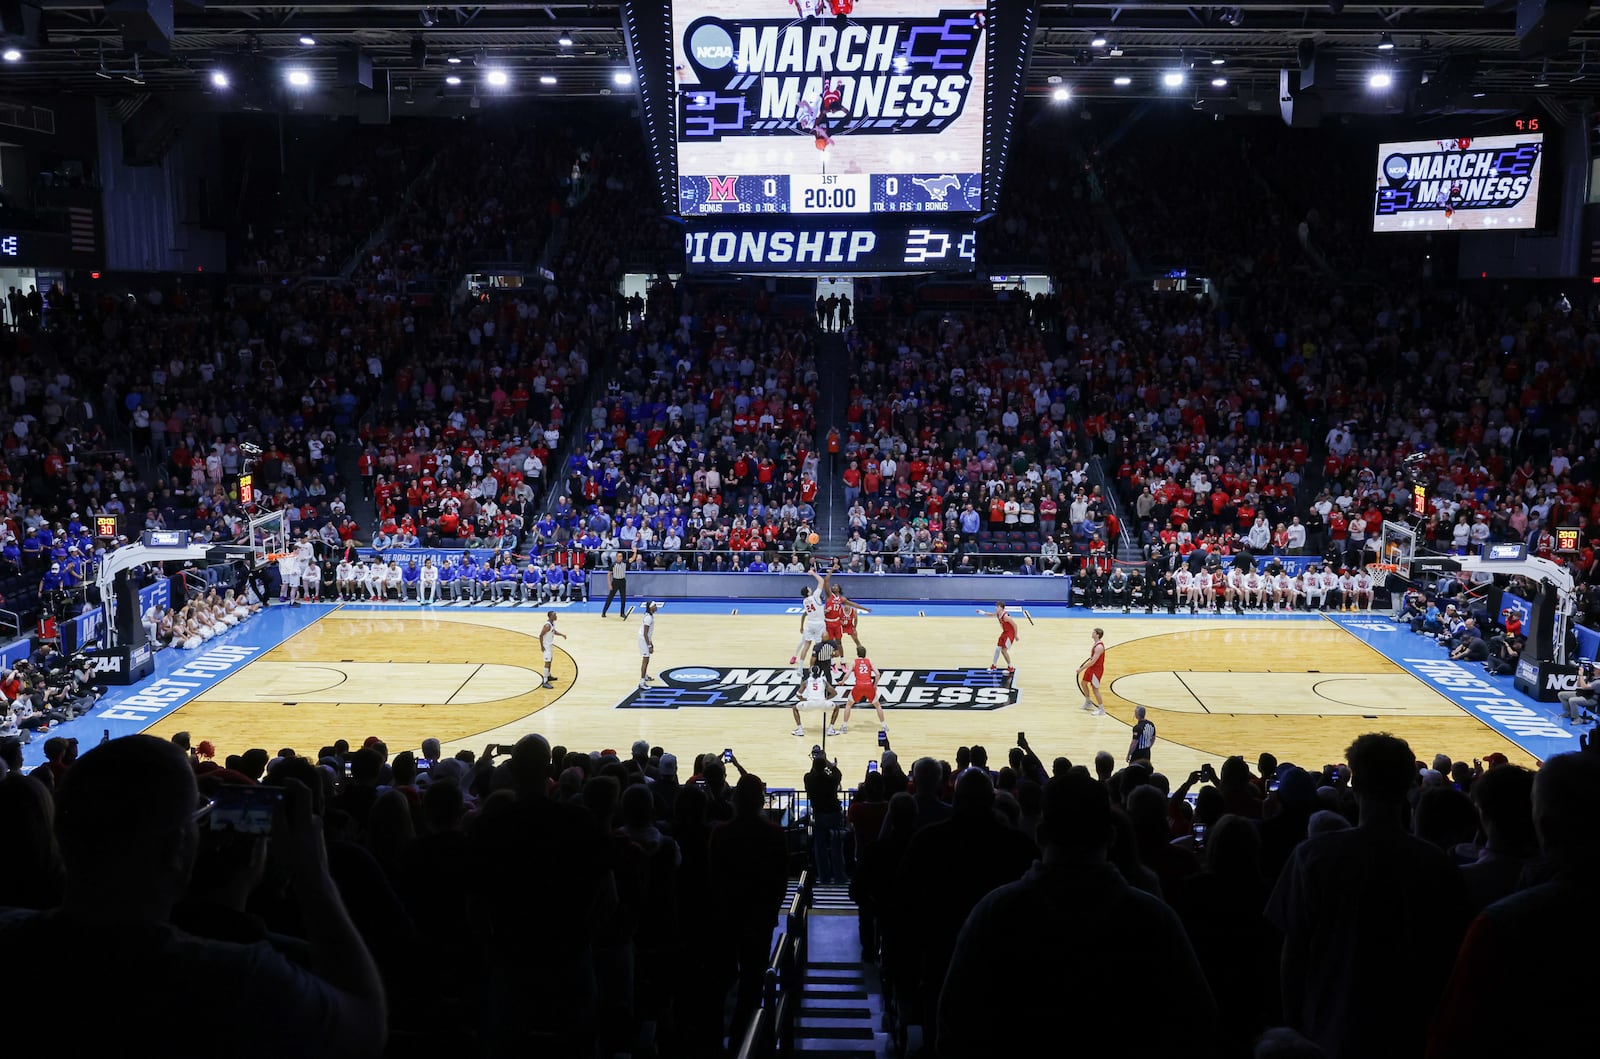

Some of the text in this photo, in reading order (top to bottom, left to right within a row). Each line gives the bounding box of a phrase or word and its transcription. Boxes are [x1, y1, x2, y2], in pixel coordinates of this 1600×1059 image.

[697, 46, 733, 59] NCAA
[737, 25, 899, 73] MARCH
[1515, 119, 1538, 130] 9:15
[1408, 152, 1494, 181] MARCH
[822, 176, 838, 185] 1ST
[764, 178, 776, 197] 0
[886, 177, 898, 196] 0
[804, 188, 856, 208] 20:00
[699, 203, 722, 212] BONUS
[755, 203, 761, 212] 0
[763, 203, 776, 212] TOL
[873, 202, 885, 211] TOL
[916, 202, 922, 211] 0
[924, 202, 948, 211] BONUS
[686, 231, 876, 262] IONSHIP
[100, 526, 113, 535] 30
[1562, 539, 1574, 549] 30
[392, 554, 410, 562] ROAD
[806, 603, 816, 613] 24
[858, 666, 868, 674] 22
[96, 678, 202, 721] FIRST
[170, 645, 260, 679] FOUR
[1402, 658, 1506, 696] FIRST
[1461, 696, 1574, 738] FOUR
